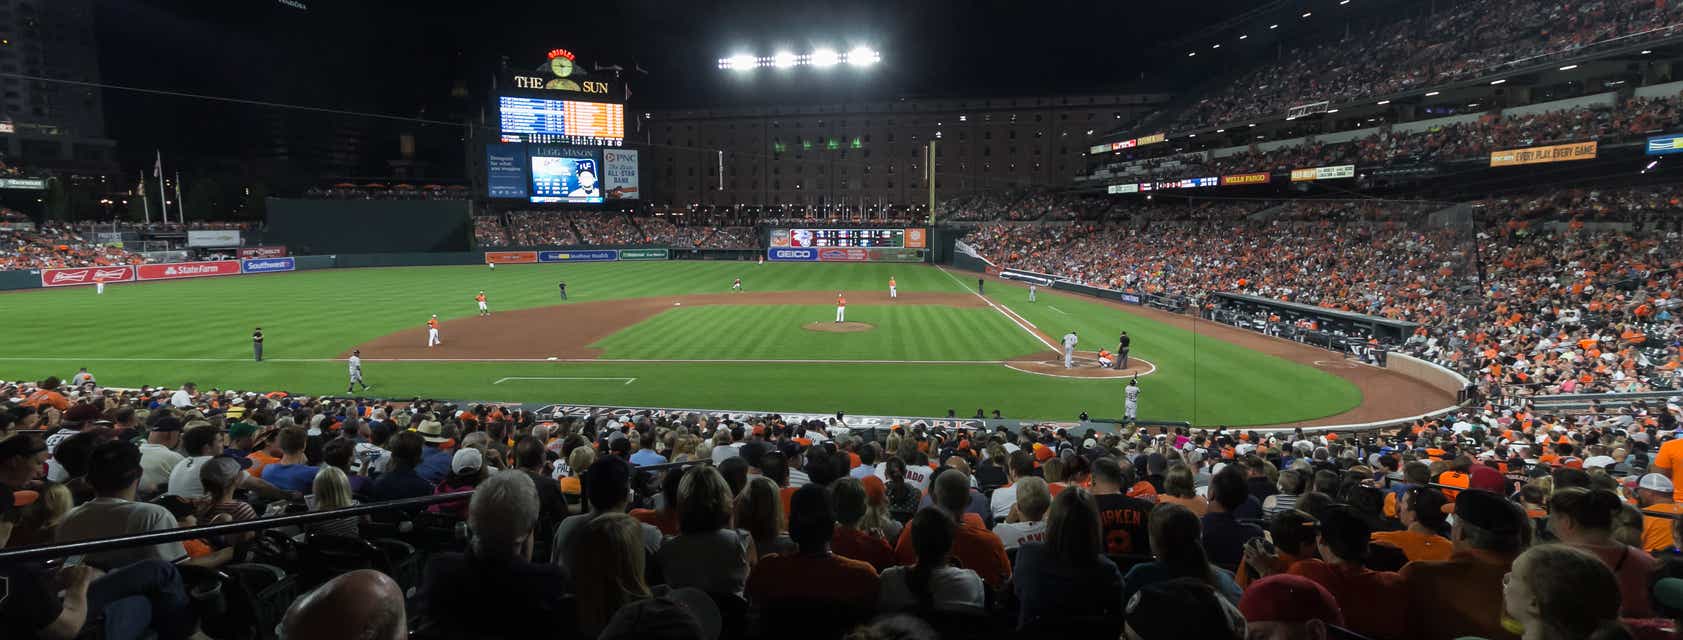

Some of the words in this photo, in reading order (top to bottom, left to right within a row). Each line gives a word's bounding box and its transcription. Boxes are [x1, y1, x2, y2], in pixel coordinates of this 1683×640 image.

[514, 76, 544, 89] THE
[582, 81, 608, 94] SUN
[1515, 151, 1535, 161] EVERY
[1553, 147, 1574, 158] EVERY
[1246, 174, 1265, 182] FARGO
[776, 249, 811, 258] GEICO
[248, 261, 285, 269] Southwest
